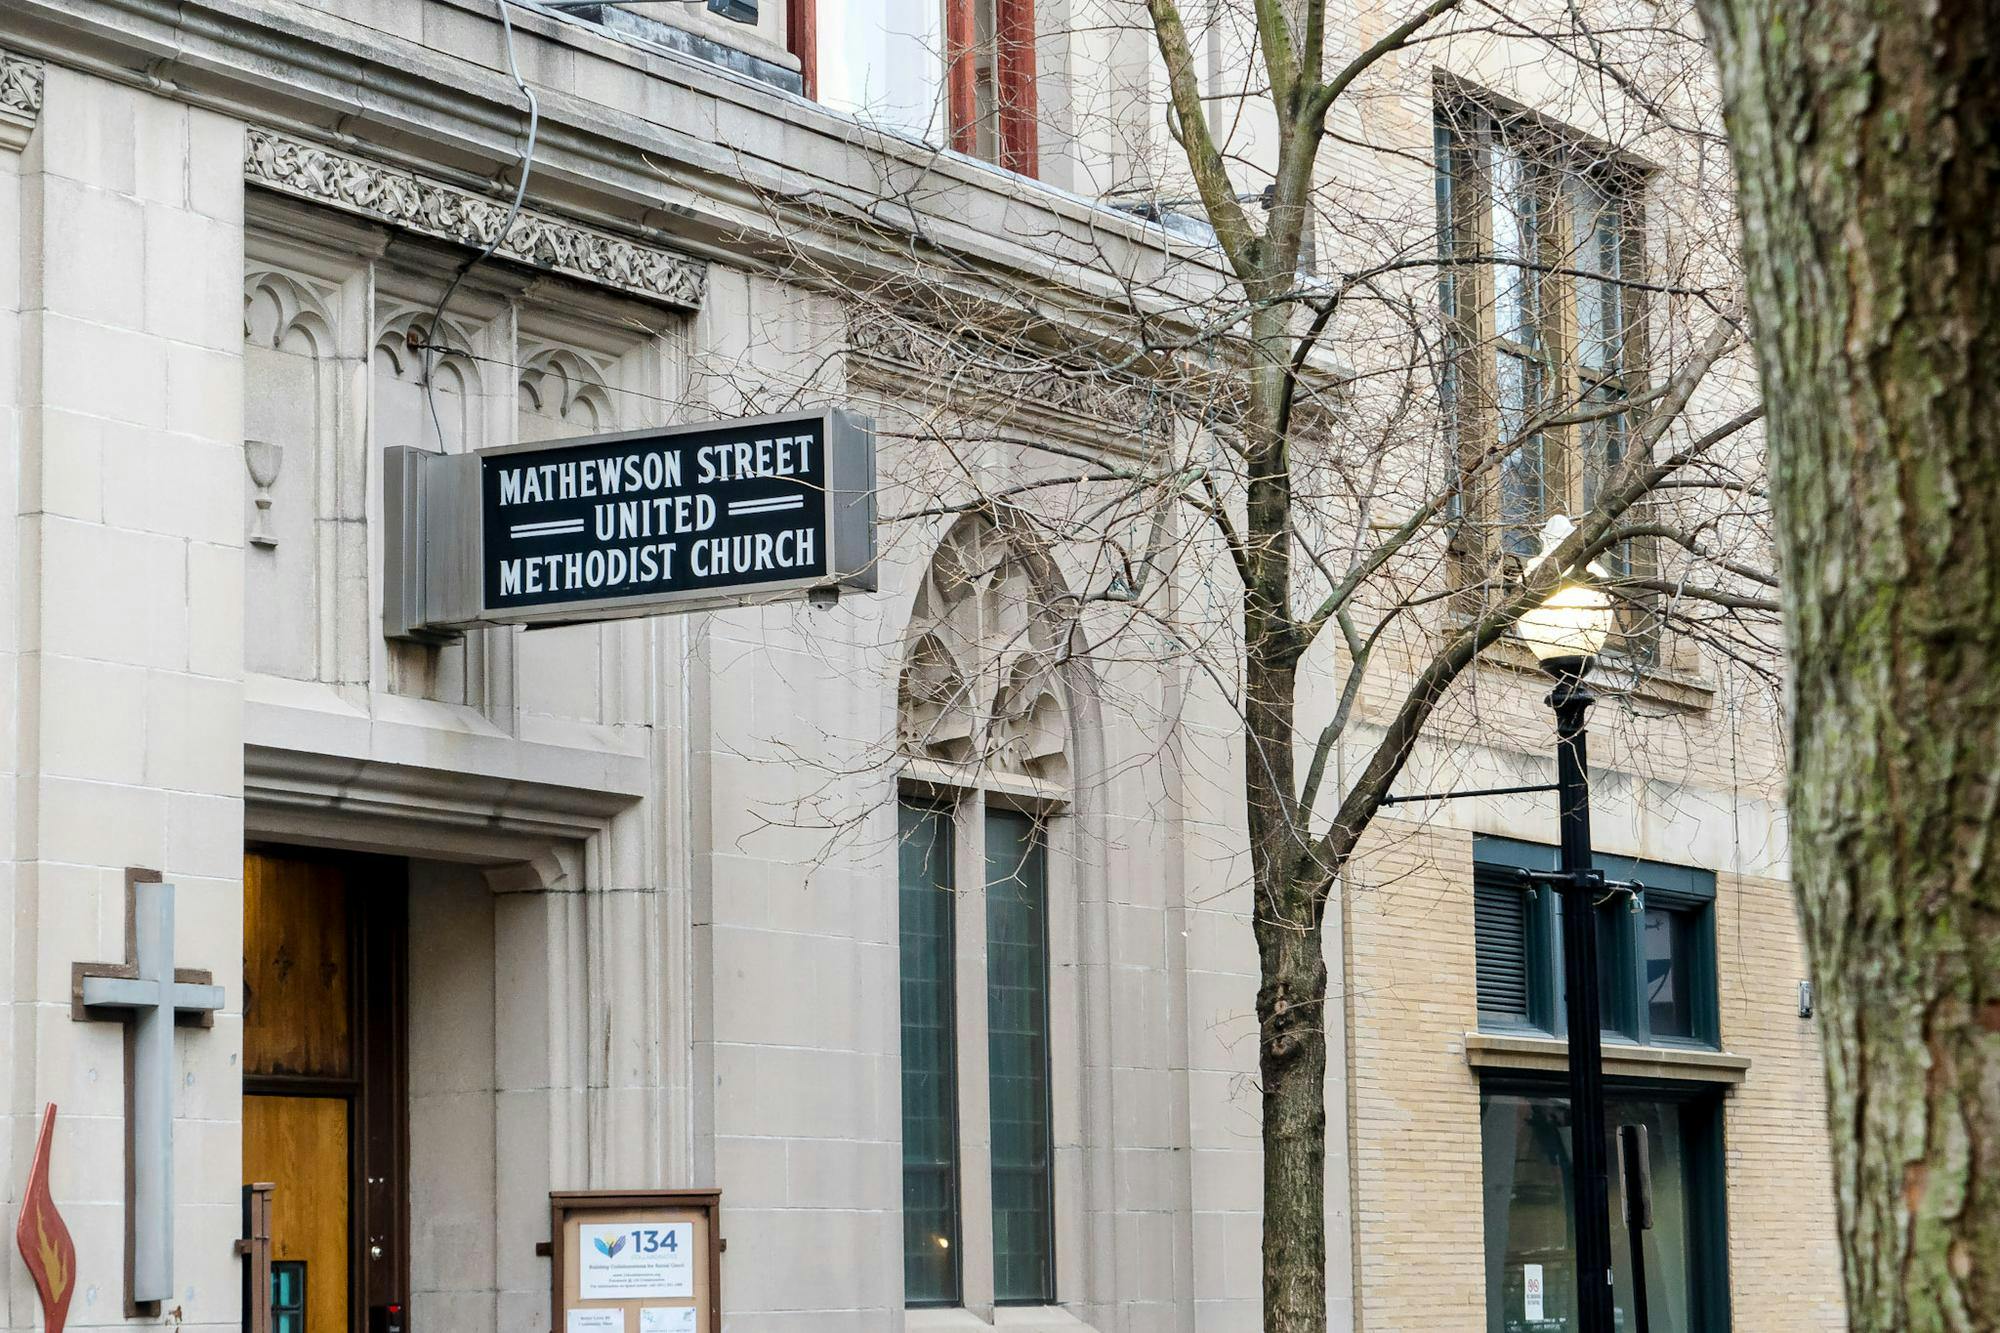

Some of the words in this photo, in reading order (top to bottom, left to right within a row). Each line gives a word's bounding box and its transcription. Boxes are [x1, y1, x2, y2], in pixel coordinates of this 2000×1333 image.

[499, 450, 682, 506] MATHEWSON
[697, 434, 814, 485] STREET
[594, 494, 716, 541] UNITED
[499, 542, 676, 596] METHODIST
[690, 527, 815, 578] CHURCH
[631, 1230, 678, 1253] 134
